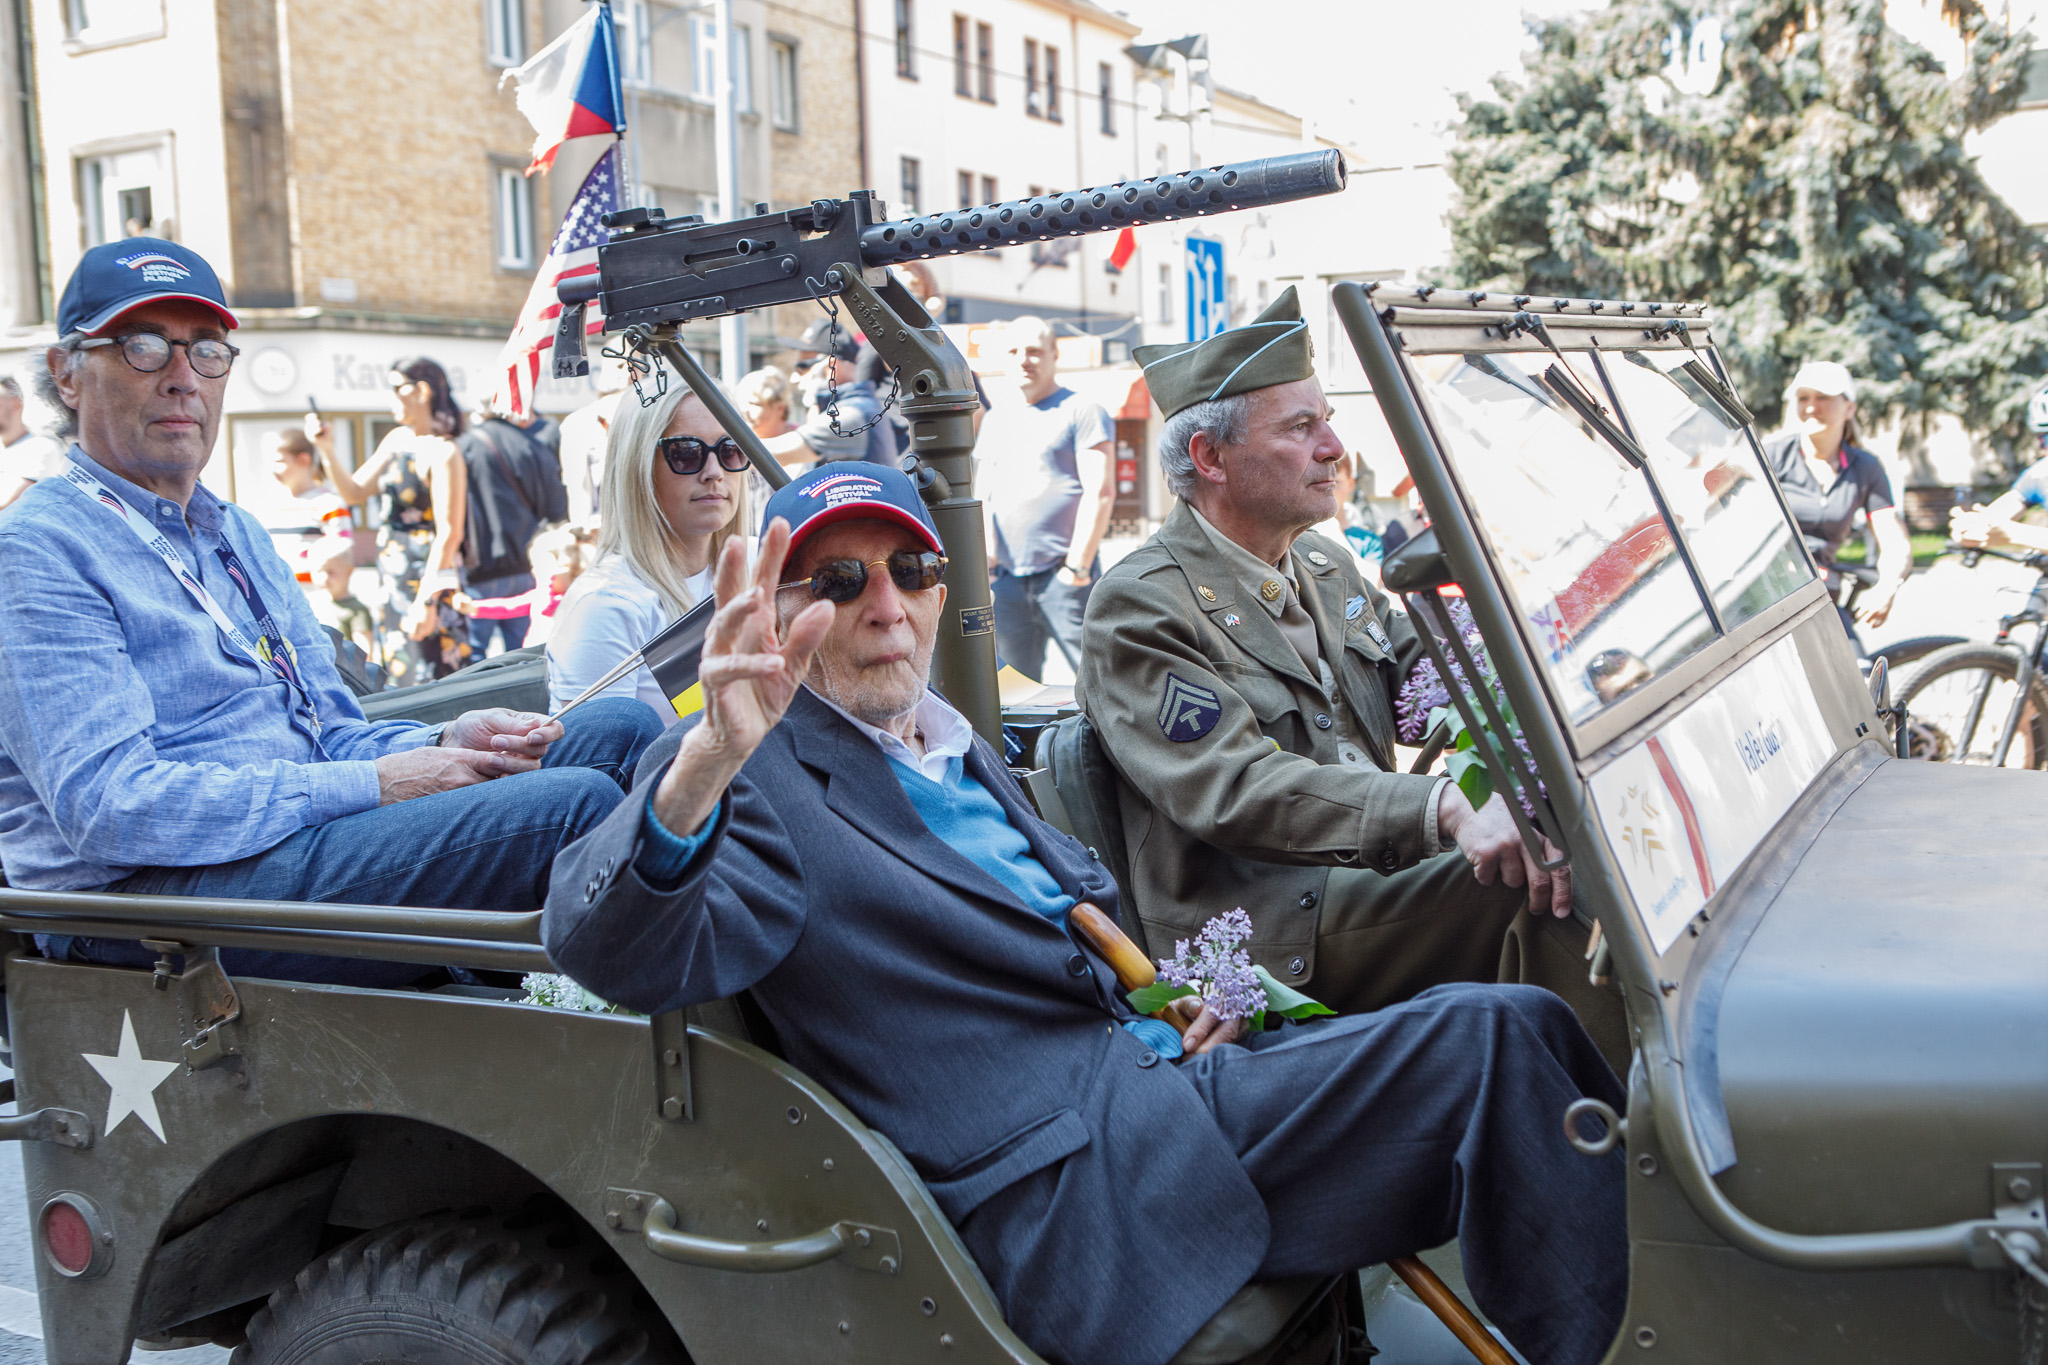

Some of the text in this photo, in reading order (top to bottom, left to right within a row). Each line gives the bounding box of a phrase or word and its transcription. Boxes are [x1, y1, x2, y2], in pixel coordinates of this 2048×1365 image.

[825, 484, 882, 497] LIBERATION
[826, 490, 873, 502] FESTIVAL
[1263, 582, 1281, 598] US
